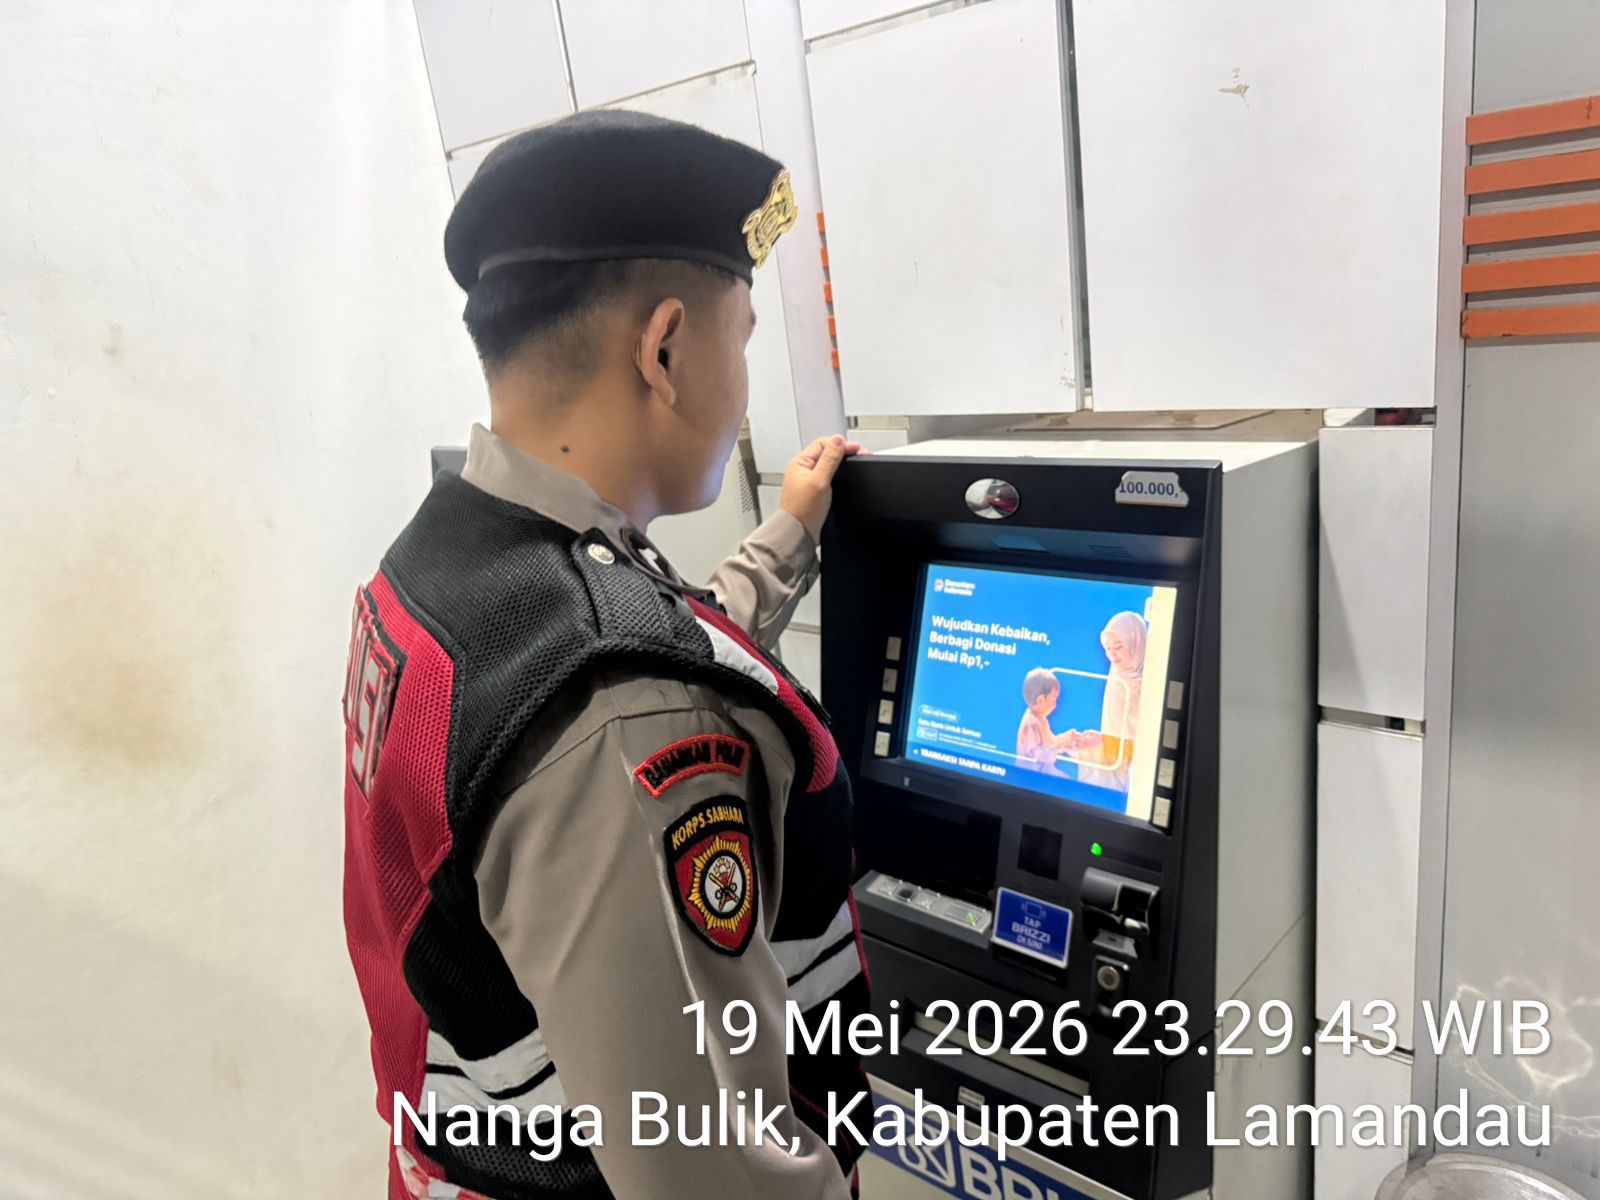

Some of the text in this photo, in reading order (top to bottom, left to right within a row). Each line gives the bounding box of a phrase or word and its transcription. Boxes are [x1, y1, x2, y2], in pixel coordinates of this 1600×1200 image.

[932, 615, 1050, 645] Wujudkan Kebaikan,
[929, 631, 1016, 655] Berbagi Donasi
[927, 647, 990, 670] Mulai Rp1,-
[672, 805, 744, 851] KORPS SABHARA
[1011, 921, 1051, 944] BRIZZI
[1024, 916, 1042, 929] TAP
